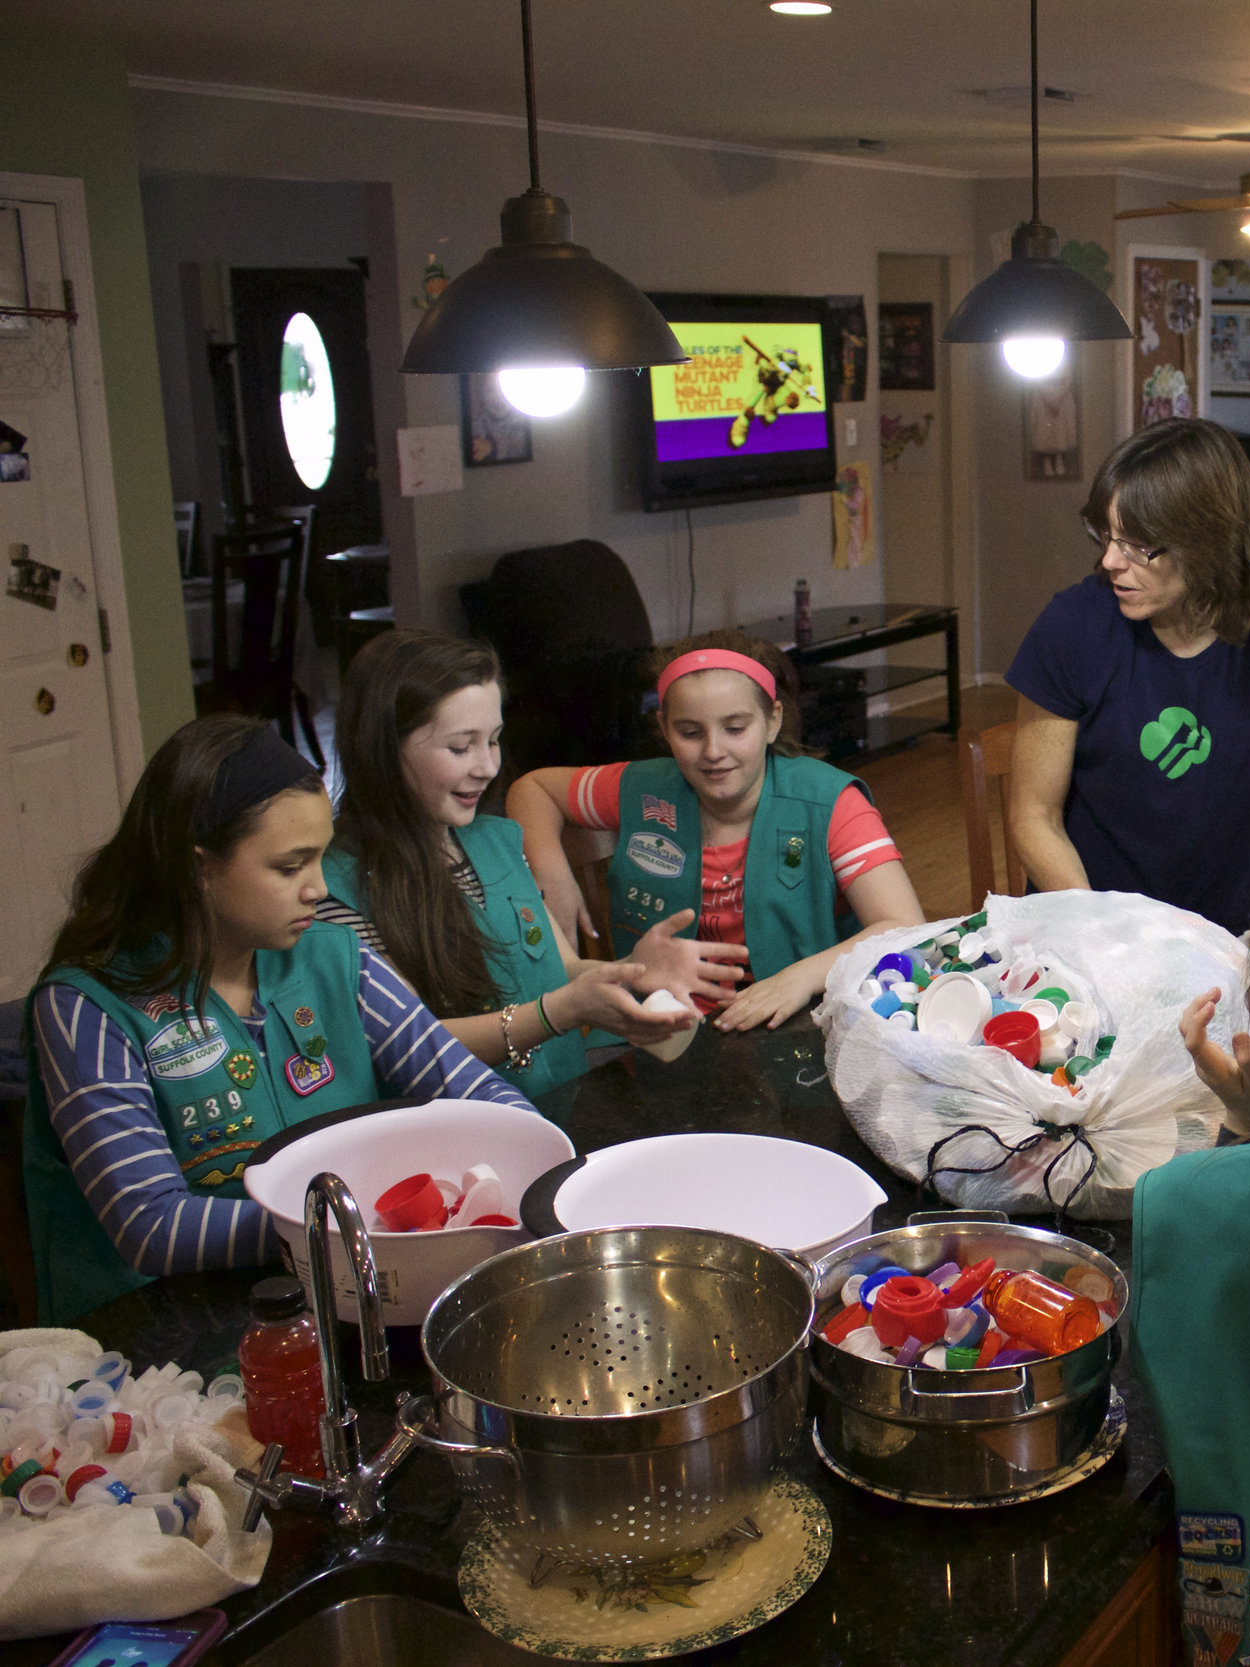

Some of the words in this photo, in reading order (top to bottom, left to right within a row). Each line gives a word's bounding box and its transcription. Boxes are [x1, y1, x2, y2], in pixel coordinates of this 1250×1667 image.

[674, 370, 739, 384] MUTANT
[675, 384, 723, 398] NINJA
[676, 396, 745, 413] TURTLES
[627, 887, 664, 911] 239
[150, 1044, 171, 1056] GIRL
[158, 1053, 195, 1073] SUFFOLK
[195, 1041, 223, 1059] COUNTY
[183, 1090, 242, 1127] 239
[1181, 1515, 1240, 1526] RECYCLING
